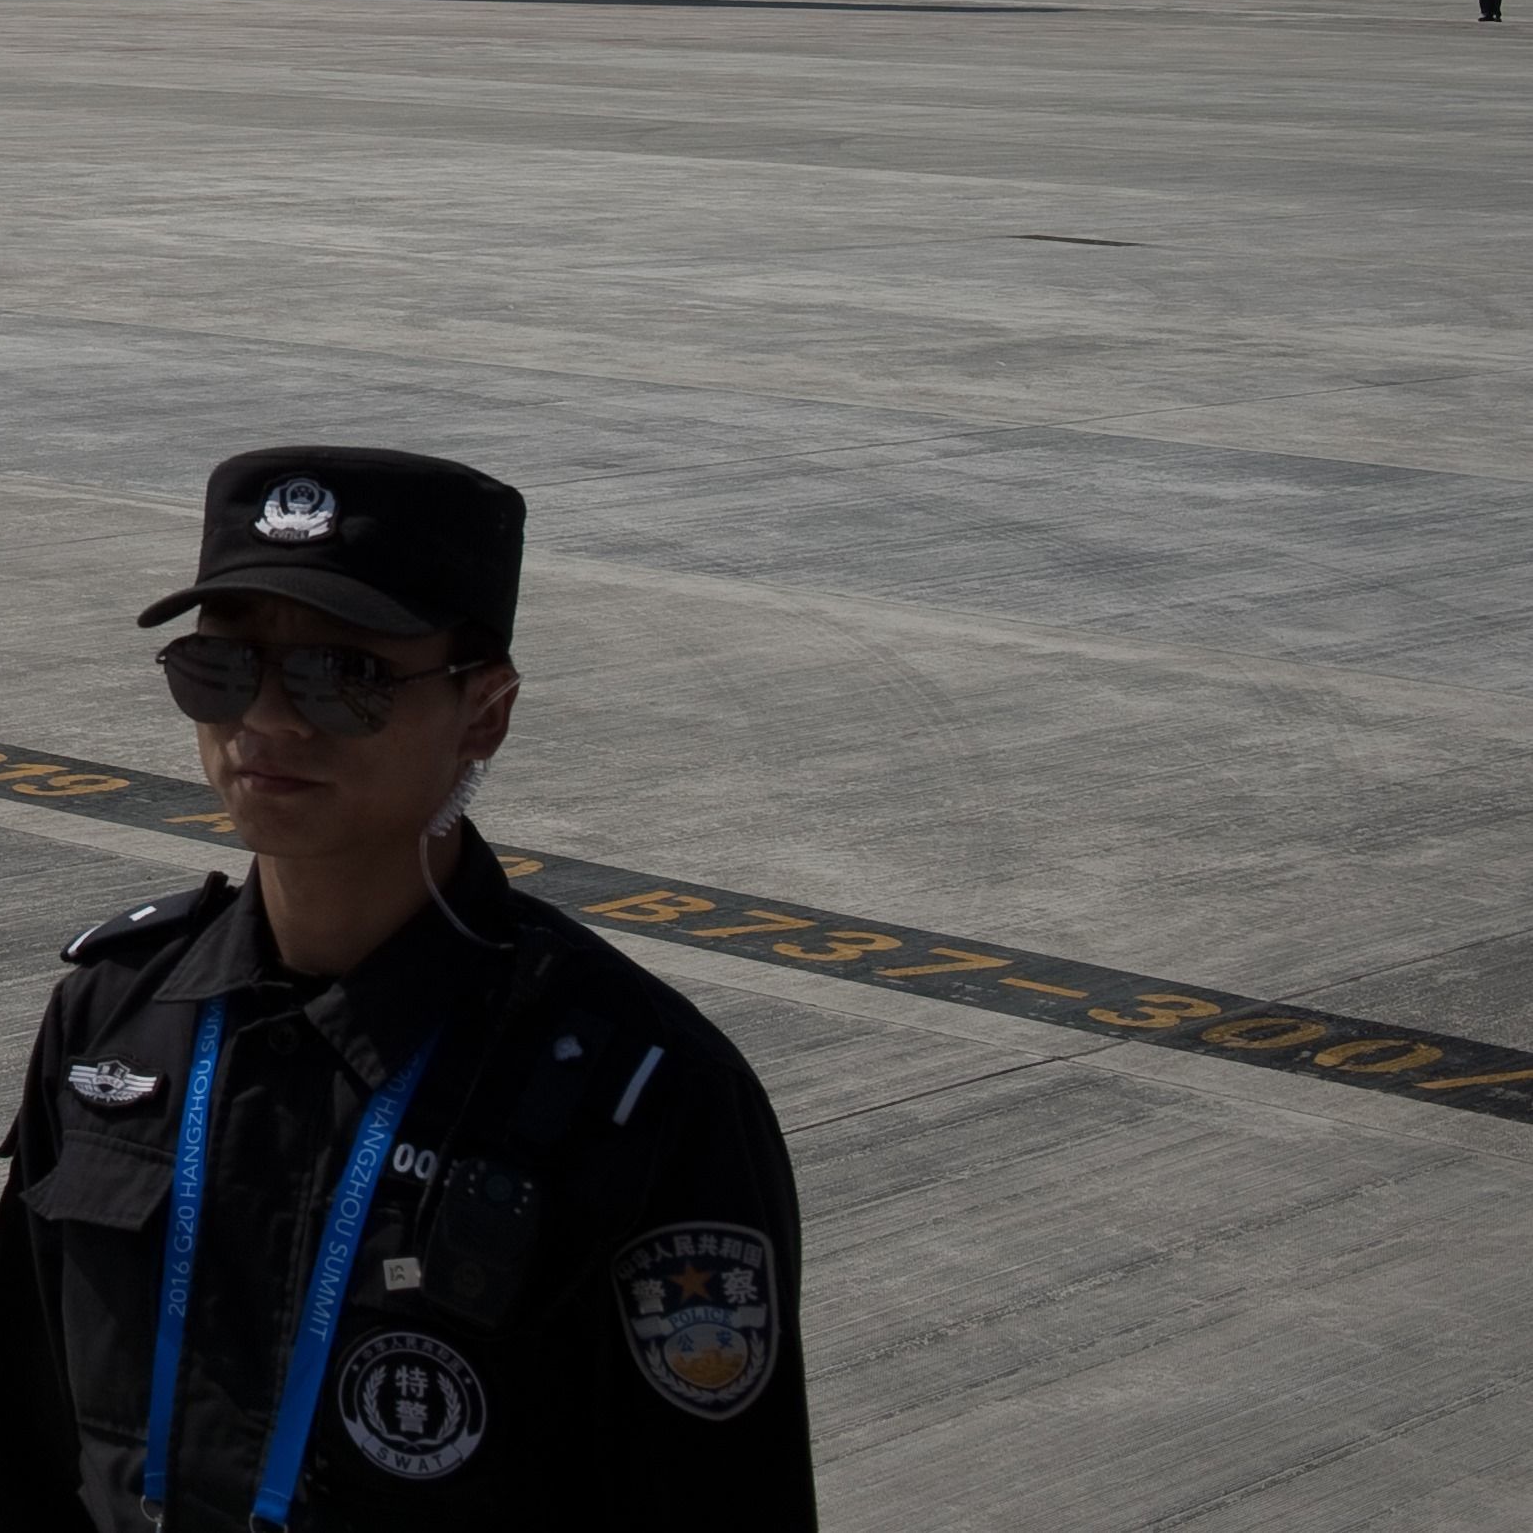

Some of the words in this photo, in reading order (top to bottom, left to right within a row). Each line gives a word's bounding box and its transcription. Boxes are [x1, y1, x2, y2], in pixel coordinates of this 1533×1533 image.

[179, 1059, 212, 1200] HANGZHOU
[334, 1096, 399, 1239] HANGZHOU
[173, 1205, 195, 1254] G20
[167, 1260, 191, 1319] 2016
[309, 1240, 348, 1343] SUMMIT
[670, 1307, 732, 1328] POLICE
[394, 1364, 430, 1435] 特警
[376, 1446, 444, 1473] SWAT
